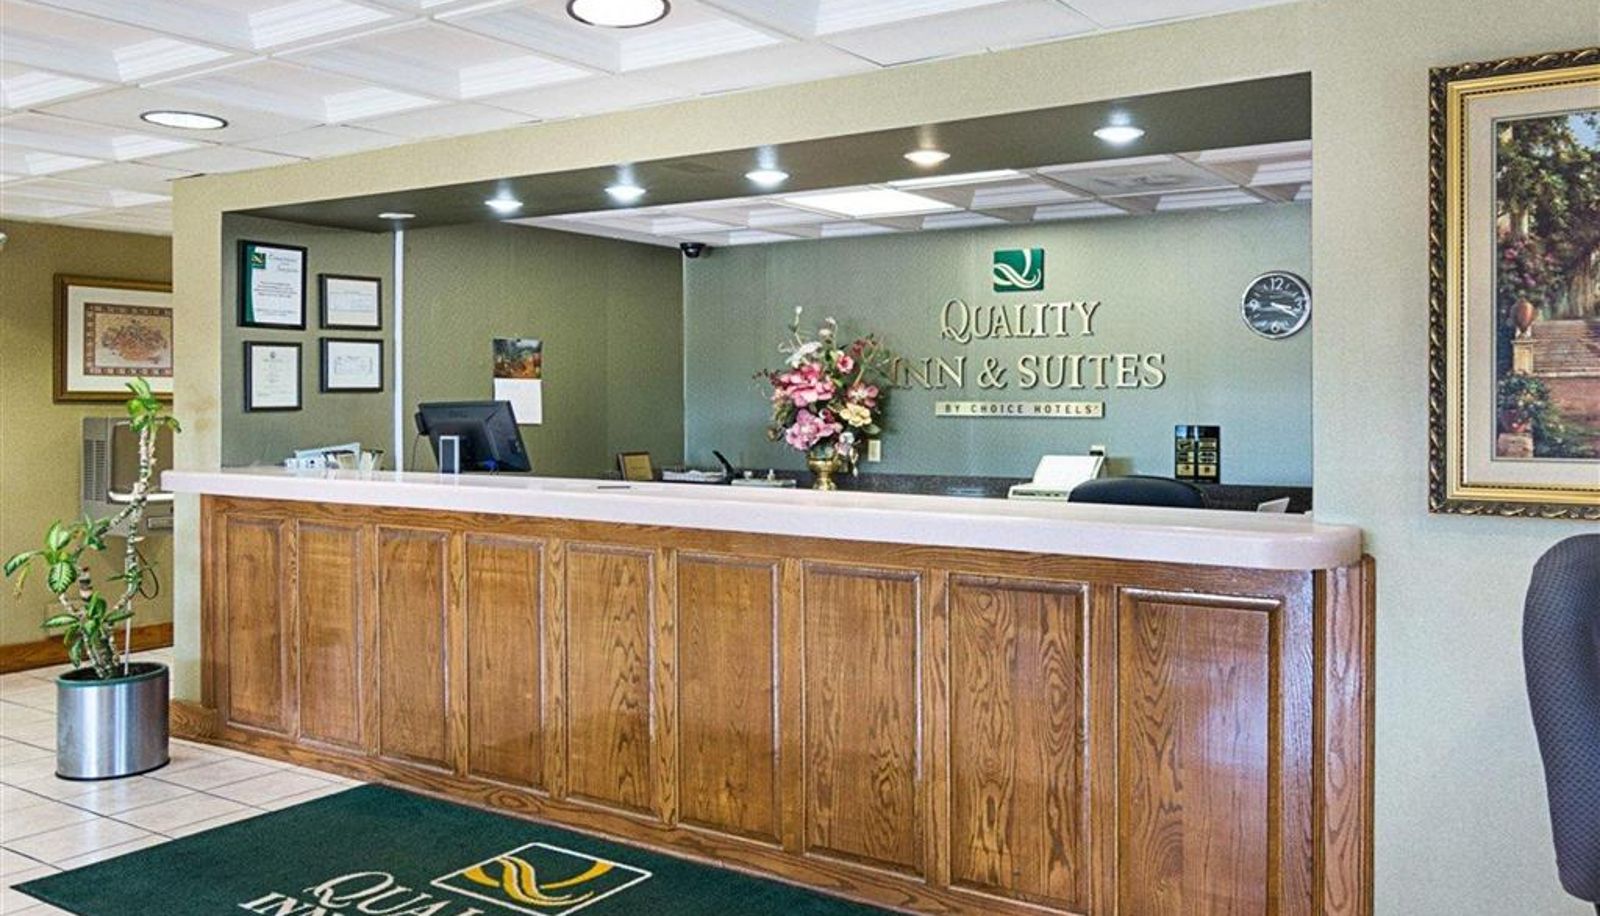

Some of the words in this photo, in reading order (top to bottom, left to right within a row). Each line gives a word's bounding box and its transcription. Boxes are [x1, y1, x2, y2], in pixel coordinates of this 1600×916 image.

[1270, 277, 1284, 290] 12
[939, 298, 1101, 344] QUALITY
[977, 356, 1008, 390] &
[1017, 353, 1166, 390] SUITES
[944, 404, 961, 414] BY
[970, 404, 1024, 414] CHOICE
[1033, 404, 1094, 414] HOTELS
[302, 871, 485, 916] QUA
